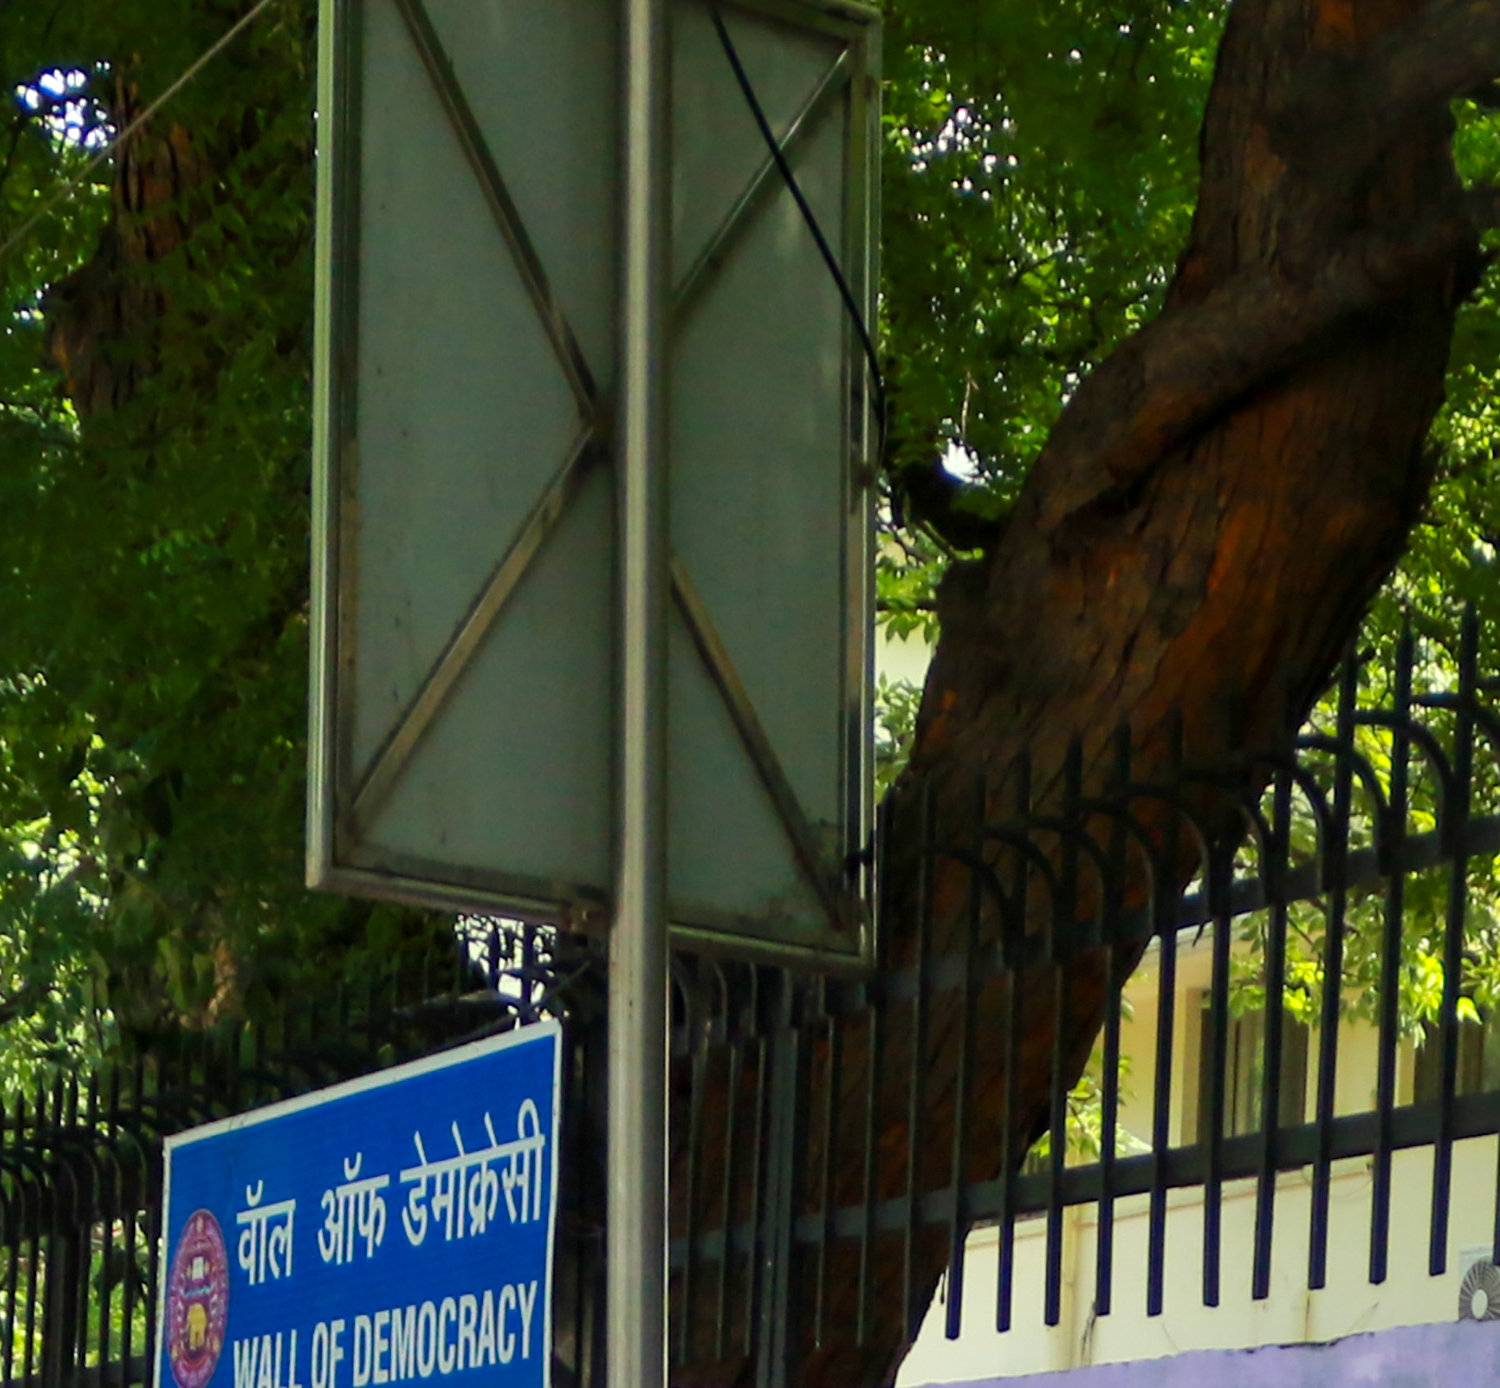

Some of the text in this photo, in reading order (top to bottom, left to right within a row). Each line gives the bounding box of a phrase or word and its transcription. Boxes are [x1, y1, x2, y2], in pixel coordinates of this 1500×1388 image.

[236, 1098, 545, 1285] वॉल ऑफ डेमोक्रेसी
[353, 1280, 537, 1388] DEMOCRACY
